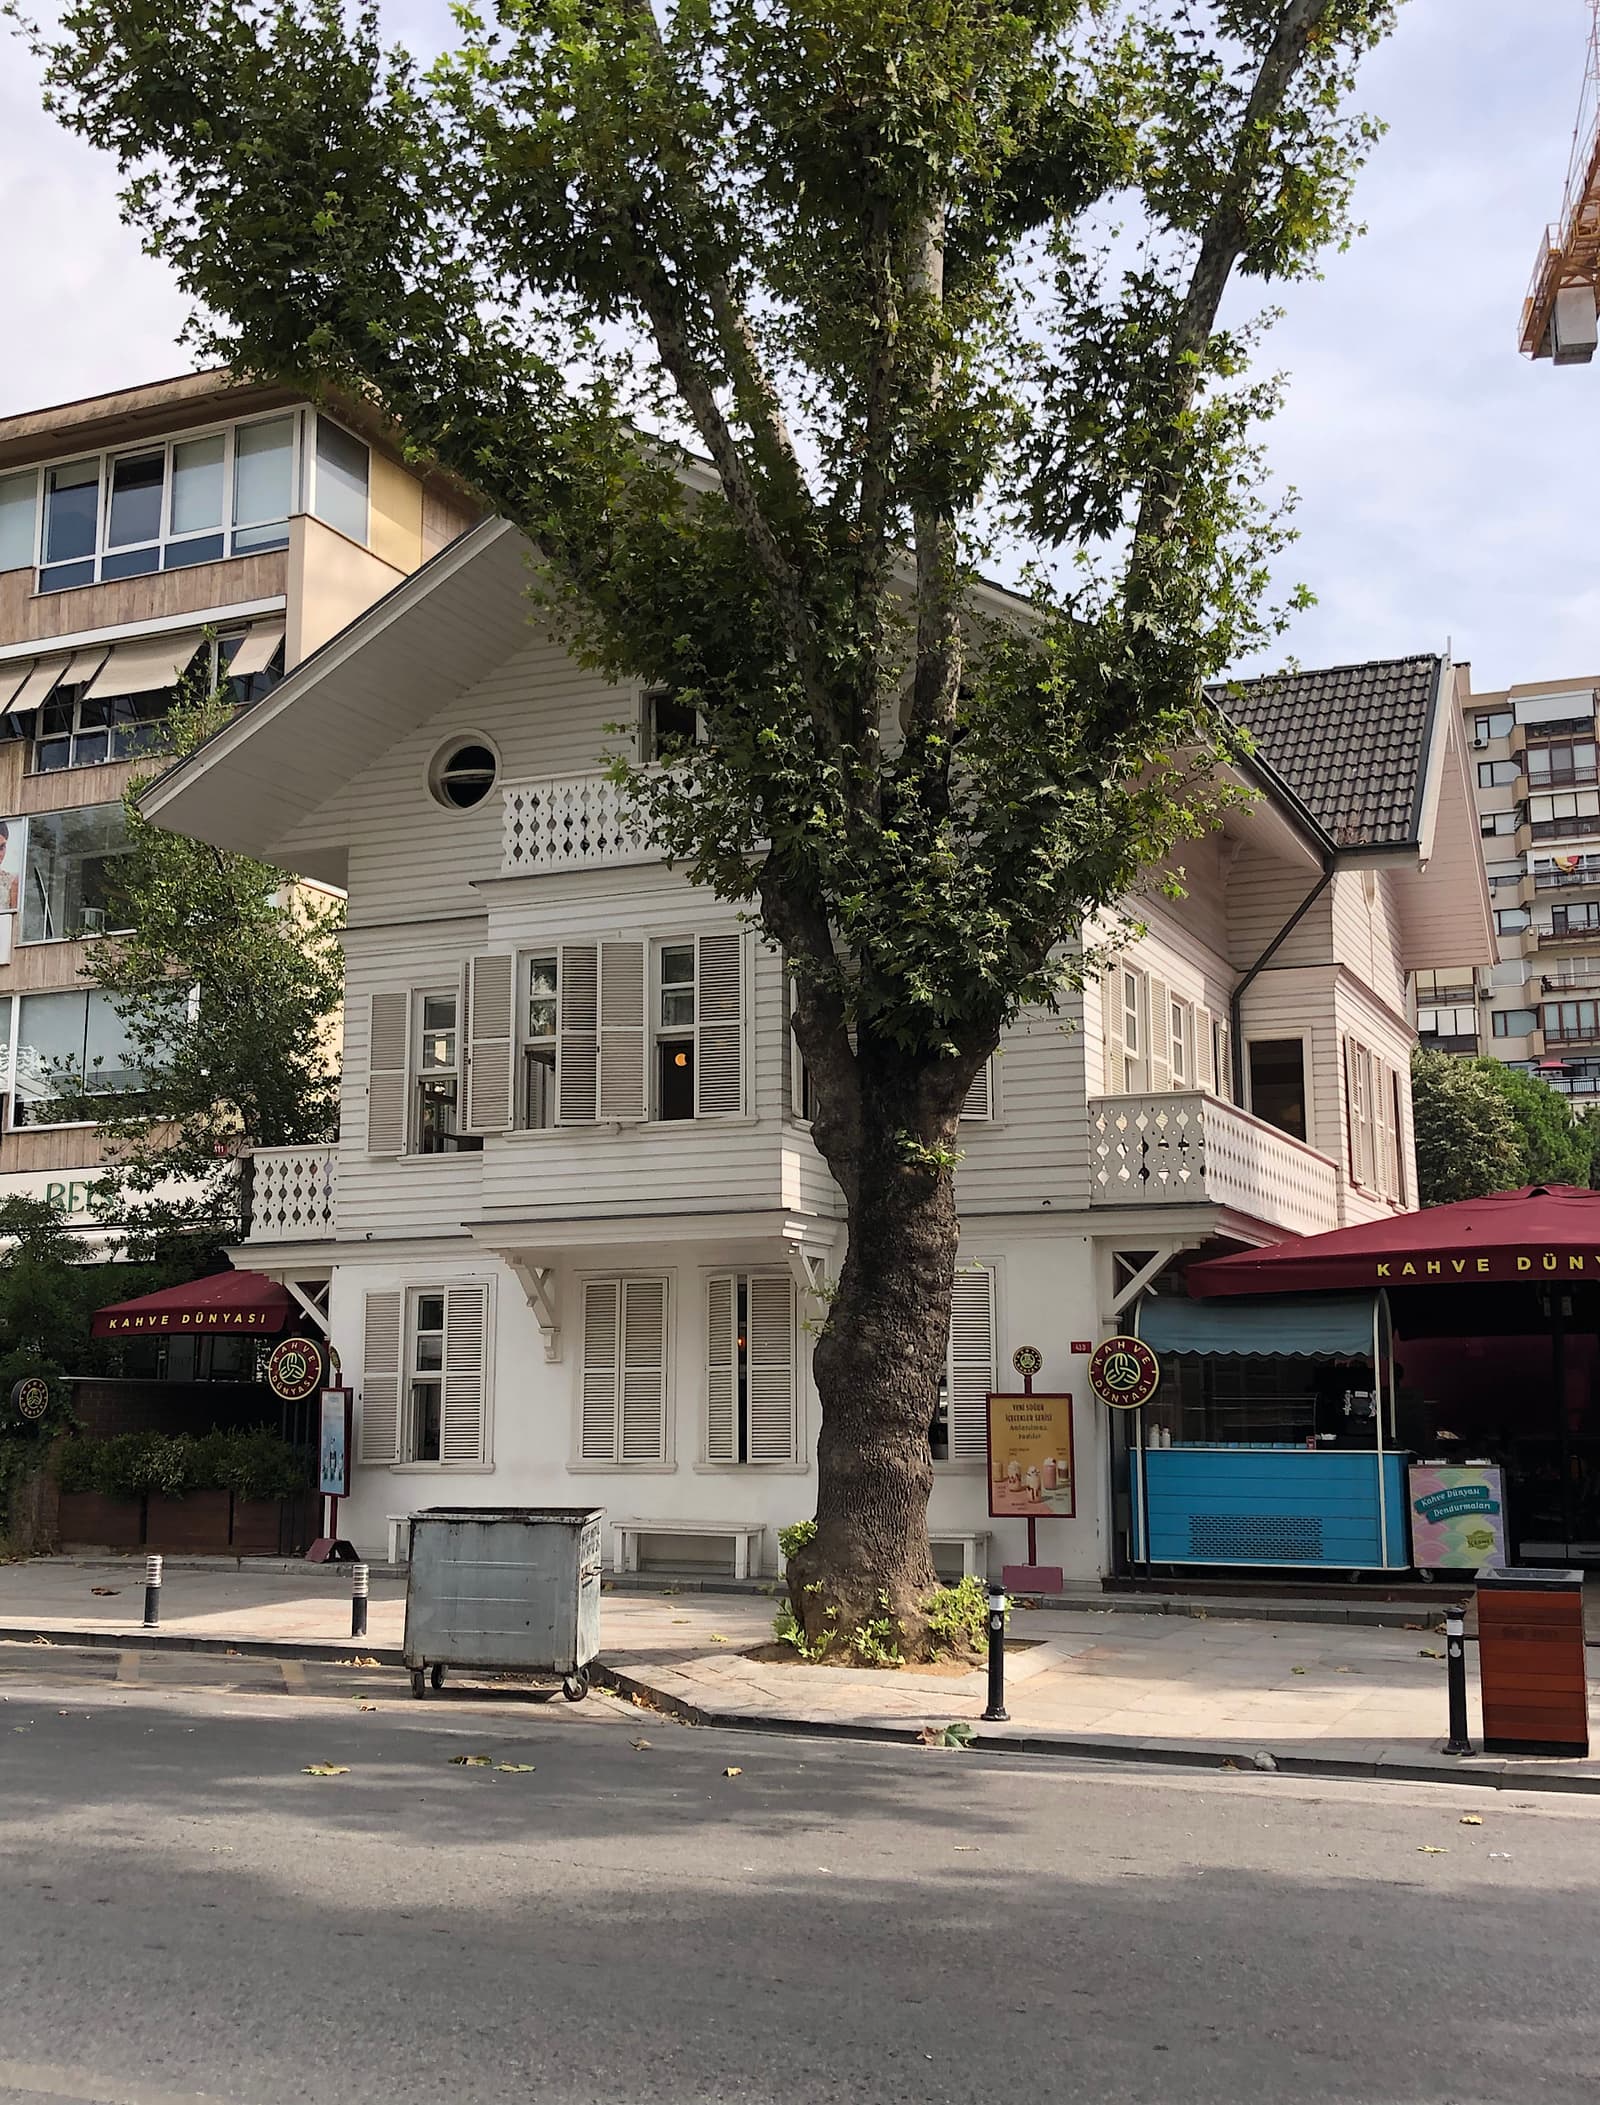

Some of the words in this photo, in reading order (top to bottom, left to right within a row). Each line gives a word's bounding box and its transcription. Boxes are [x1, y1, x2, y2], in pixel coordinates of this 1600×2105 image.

[1377, 1258, 1490, 1277] KAHVE
[1517, 1253, 1600, 1271] DÜN
[109, 1315, 169, 1329] KAHVE
[181, 1312, 265, 1324] DÜNYASI
[273, 1342, 316, 1363] KAHVE
[1094, 1341, 1151, 1365] KAHVE
[272, 1375, 315, 1395] DÜNYASI
[1095, 1380, 1152, 1403] DÜNYASI
[1421, 1493, 1446, 1508] Kahve
[1446, 1487, 1481, 1498] Dünyası
